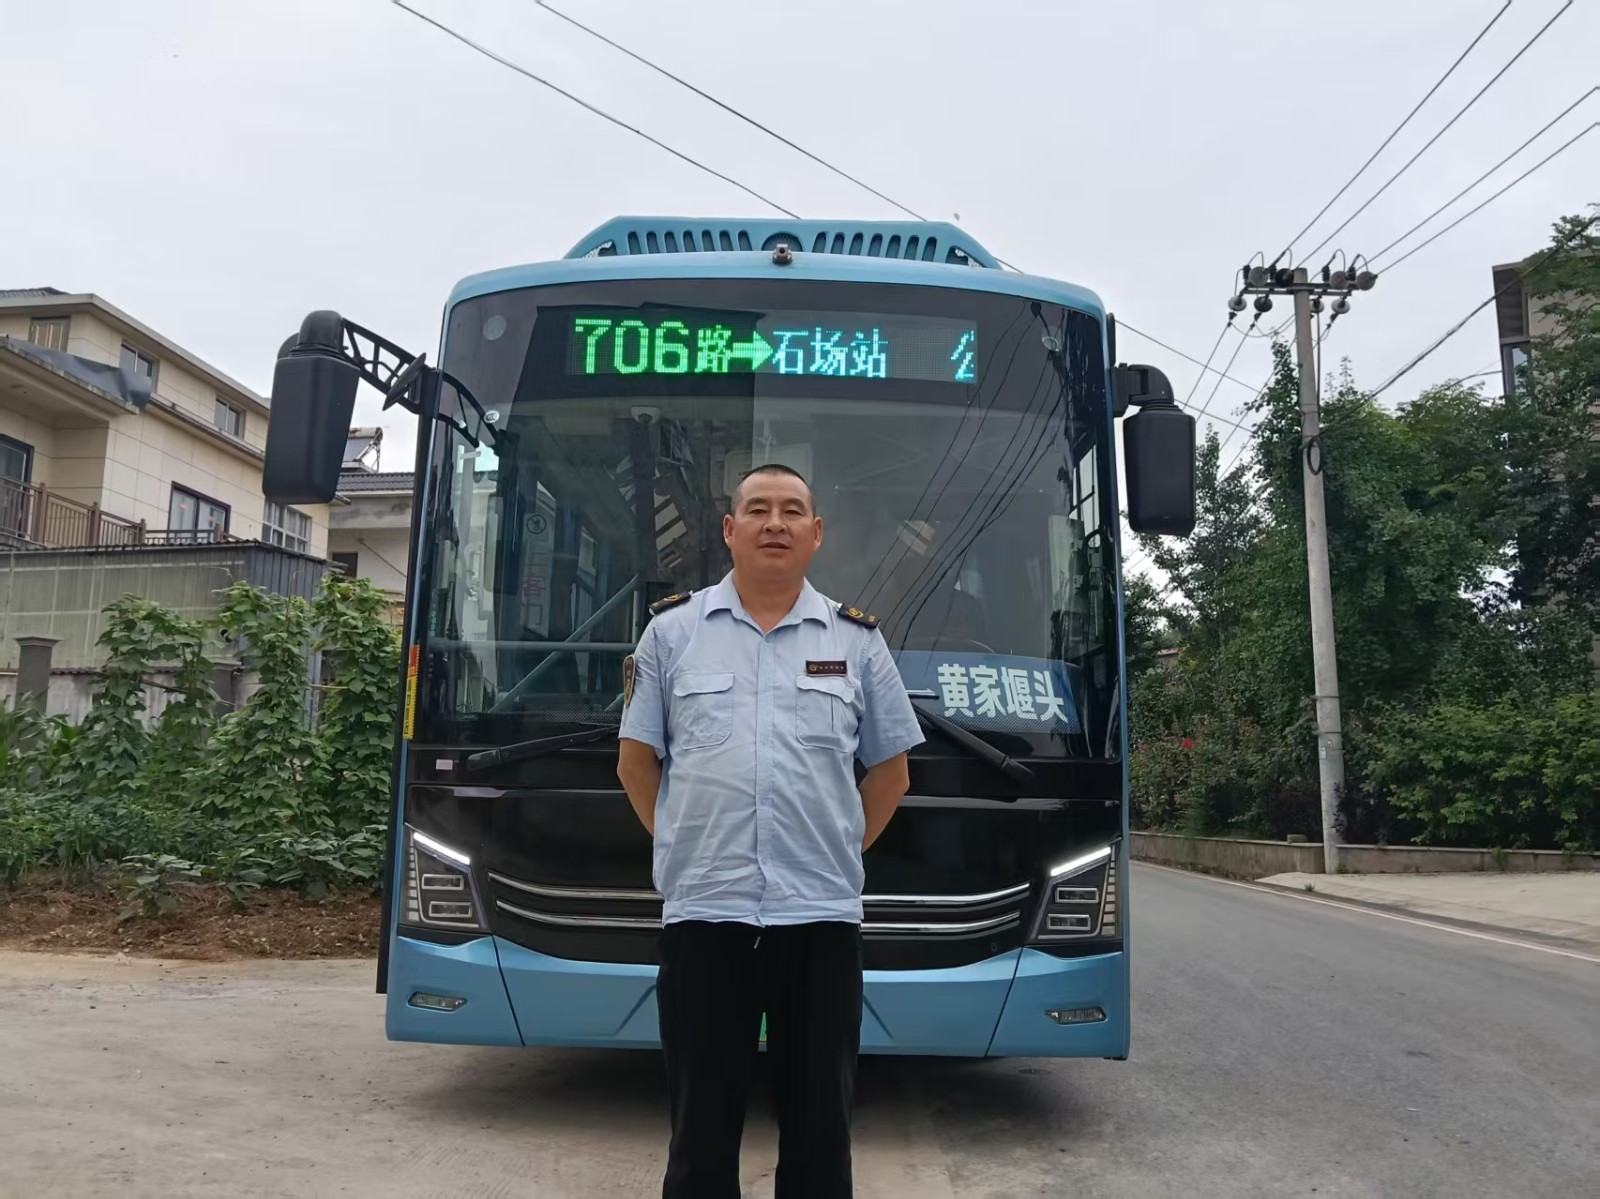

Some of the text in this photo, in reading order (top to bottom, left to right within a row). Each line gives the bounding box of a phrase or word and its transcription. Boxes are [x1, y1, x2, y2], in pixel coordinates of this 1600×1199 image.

[575, 318, 732, 374] 706路
[772, 327, 888, 378] 石场站
[937, 663, 1069, 724] 黄家堰头
